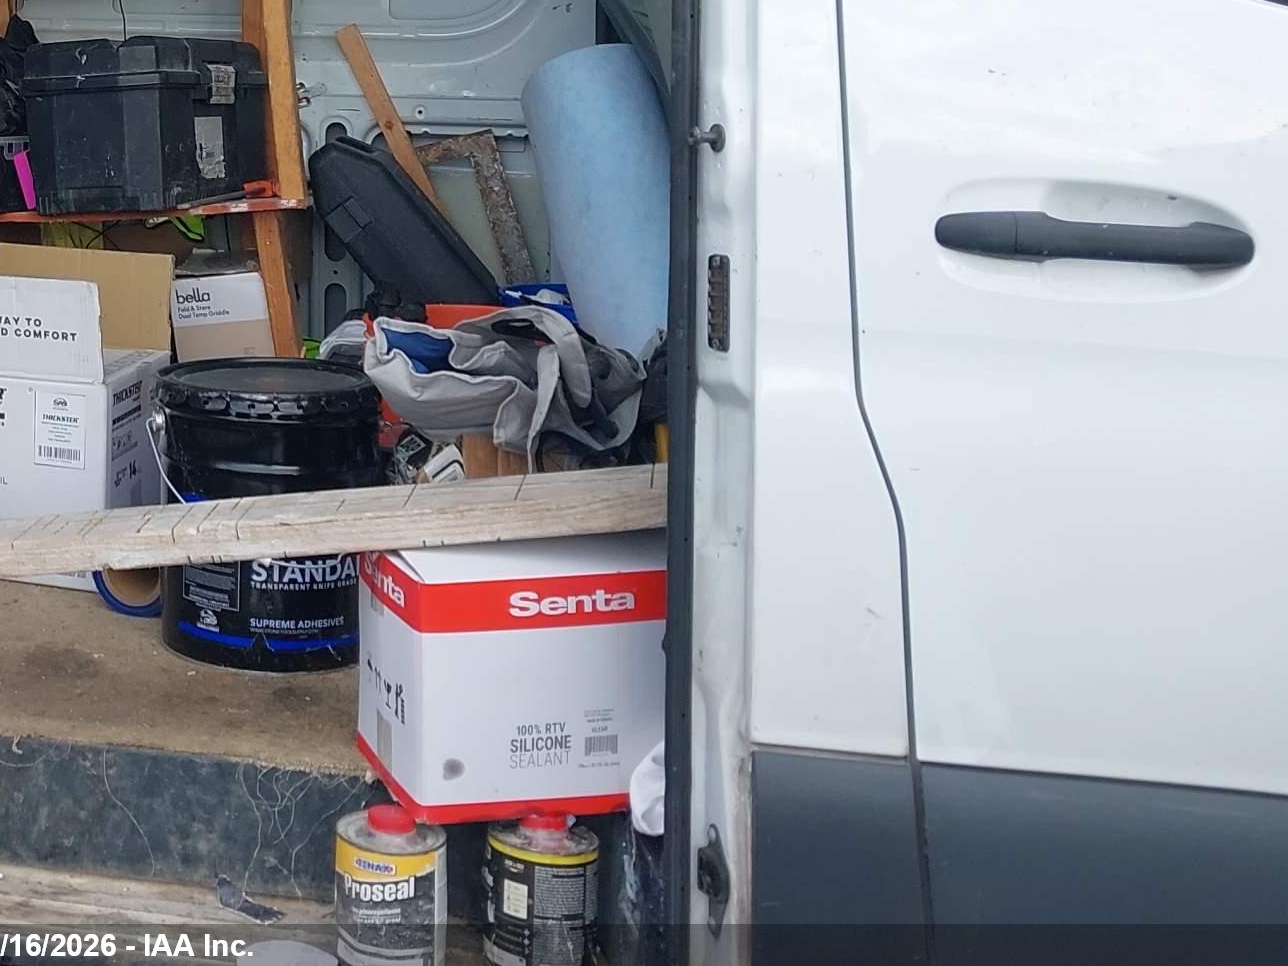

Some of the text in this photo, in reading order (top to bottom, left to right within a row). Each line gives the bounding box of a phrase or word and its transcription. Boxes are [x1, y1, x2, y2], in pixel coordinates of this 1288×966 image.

[175, 287, 211, 304] bella
[25, 317, 42, 327] TO
[14, 328, 77, 341] COMFORT
[250, 581, 311, 592] TRANSPARENT
[313, 582, 336, 590] KNIFE
[509, 589, 635, 618] Senta
[249, 616, 345, 629] SUPREME ADHESIVES
[517, 721, 566, 736] 100% RTV
[510, 735, 572, 753] SILICONE
[510, 751, 569, 770] SEALANT
[344, 873, 416, 903] Proseal
